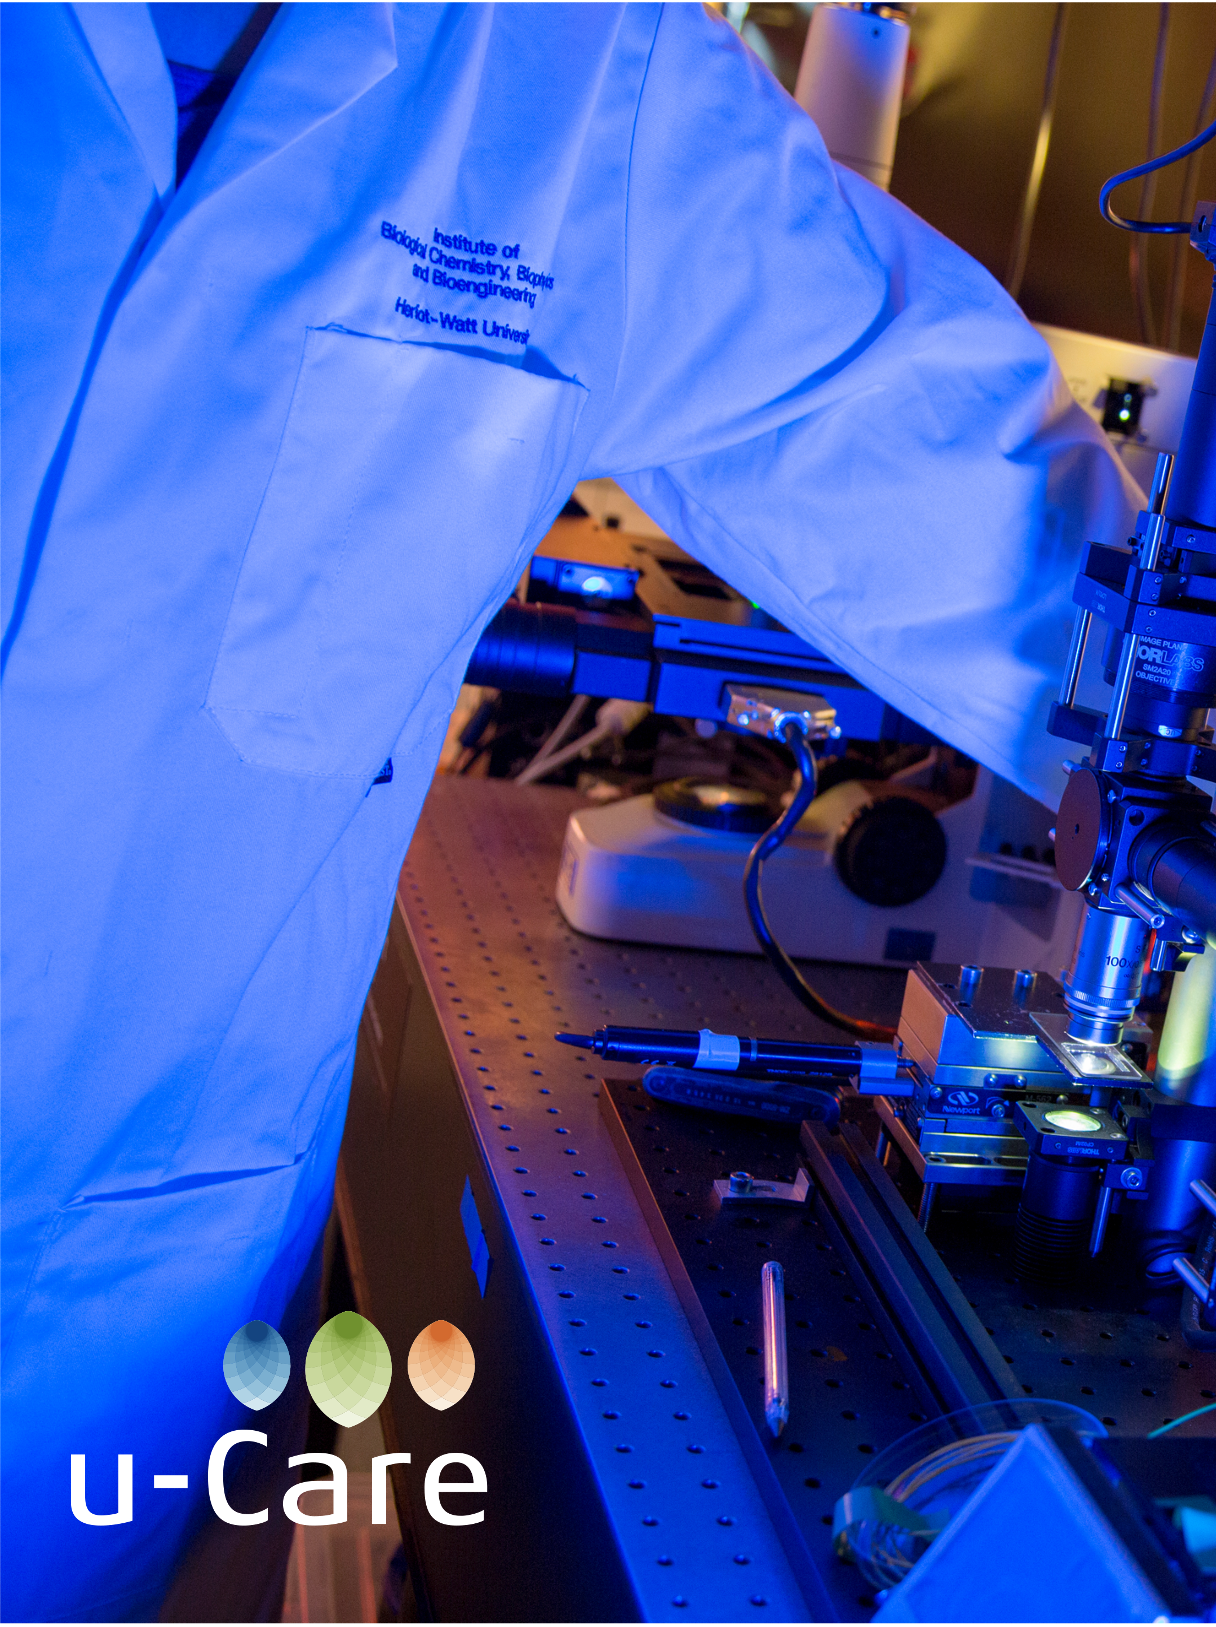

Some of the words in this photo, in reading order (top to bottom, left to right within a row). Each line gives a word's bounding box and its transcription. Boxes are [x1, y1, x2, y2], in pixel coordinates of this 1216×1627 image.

[380, 220, 428, 259] Biological
[429, 246, 510, 282] Chemistry,
[433, 227, 498, 256] Institute
[502, 243, 520, 259] of
[412, 263, 429, 283] and
[432, 268, 537, 309] Bioengineering
[394, 296, 478, 334] Heriot-Watt
[1140, 636, 1162, 646] MAGE
[1136, 644, 1204, 672] ORLABS
[1142, 663, 1172, 676] SM2A20
[942, 1106, 980, 1114] Newport
